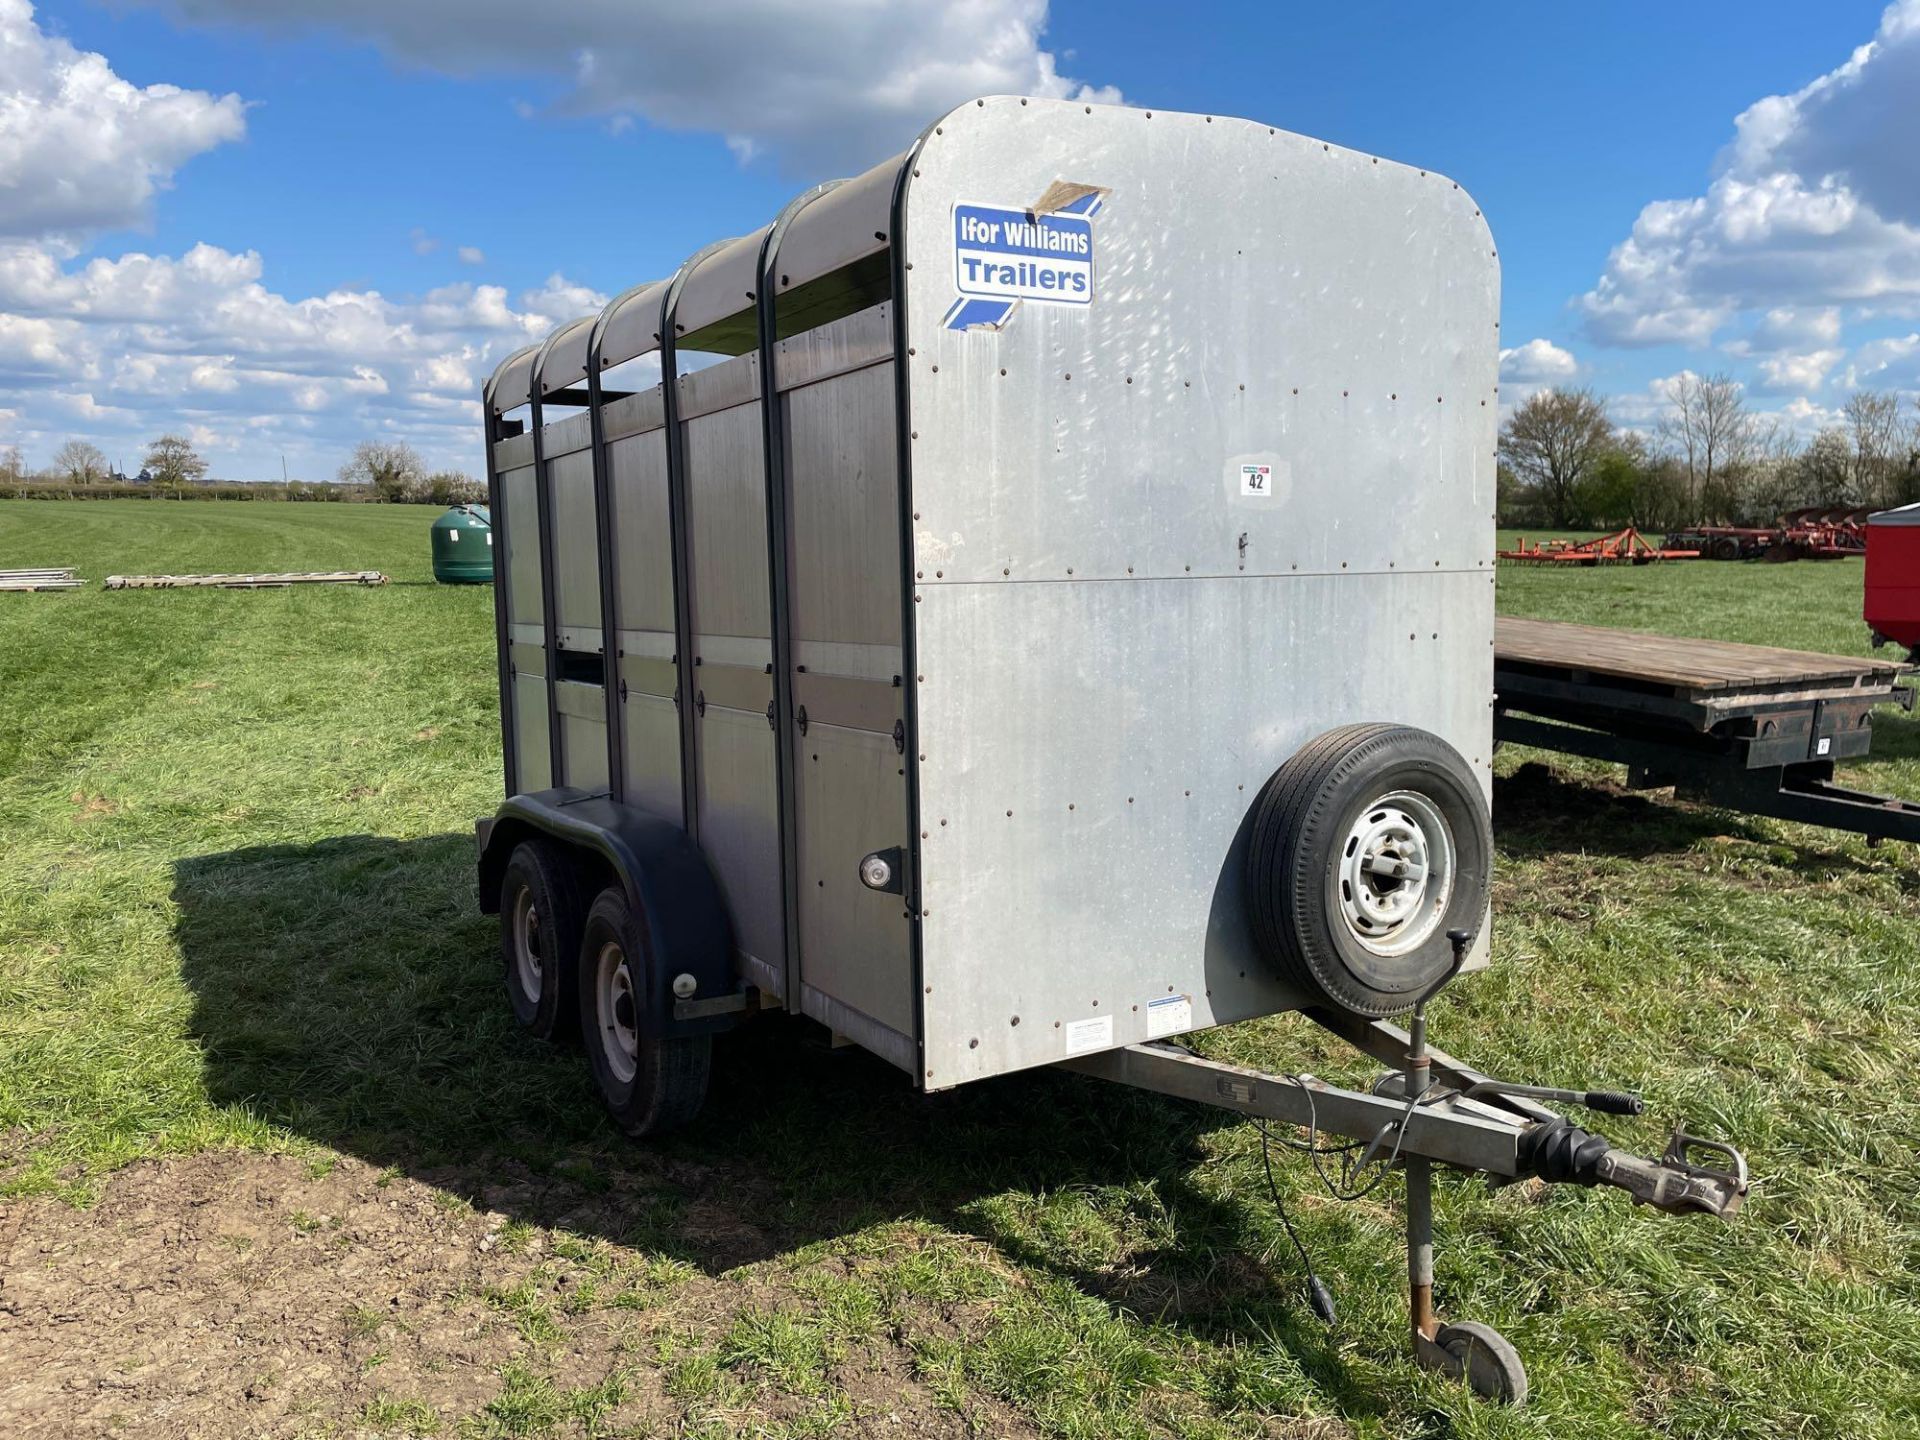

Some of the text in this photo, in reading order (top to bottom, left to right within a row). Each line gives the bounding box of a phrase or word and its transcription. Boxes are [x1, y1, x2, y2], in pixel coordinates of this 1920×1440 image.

[961, 216, 1088, 254] Ifor Williams
[962, 257, 1086, 292] Trailers
[1249, 474, 1263, 489] 42
